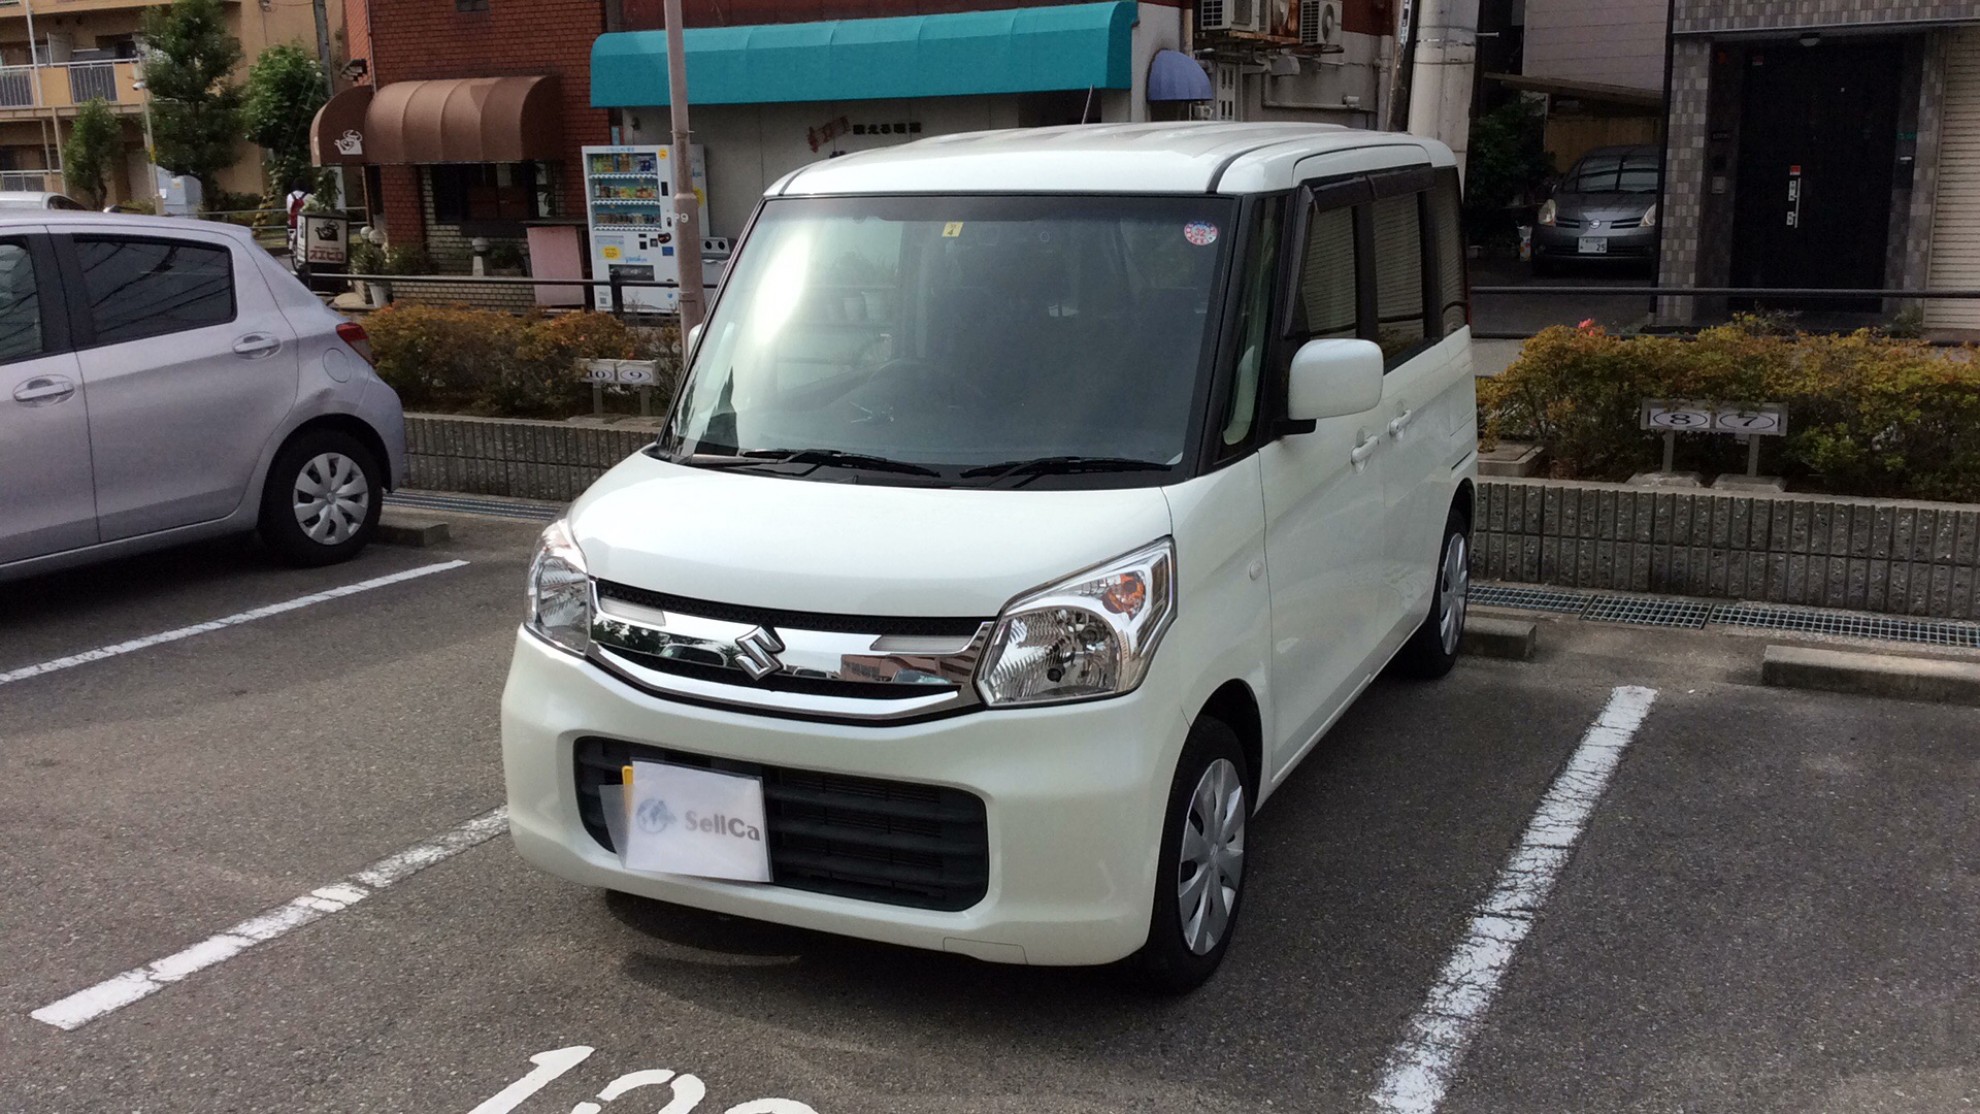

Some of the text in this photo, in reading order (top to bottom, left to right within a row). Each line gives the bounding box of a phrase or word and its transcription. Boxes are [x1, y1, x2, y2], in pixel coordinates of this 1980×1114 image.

[310, 250, 344, 261] スエヒロ
[1669, 414, 1690, 425] 8
[1738, 413, 1758, 427] 7
[684, 809, 760, 841] SellCa
